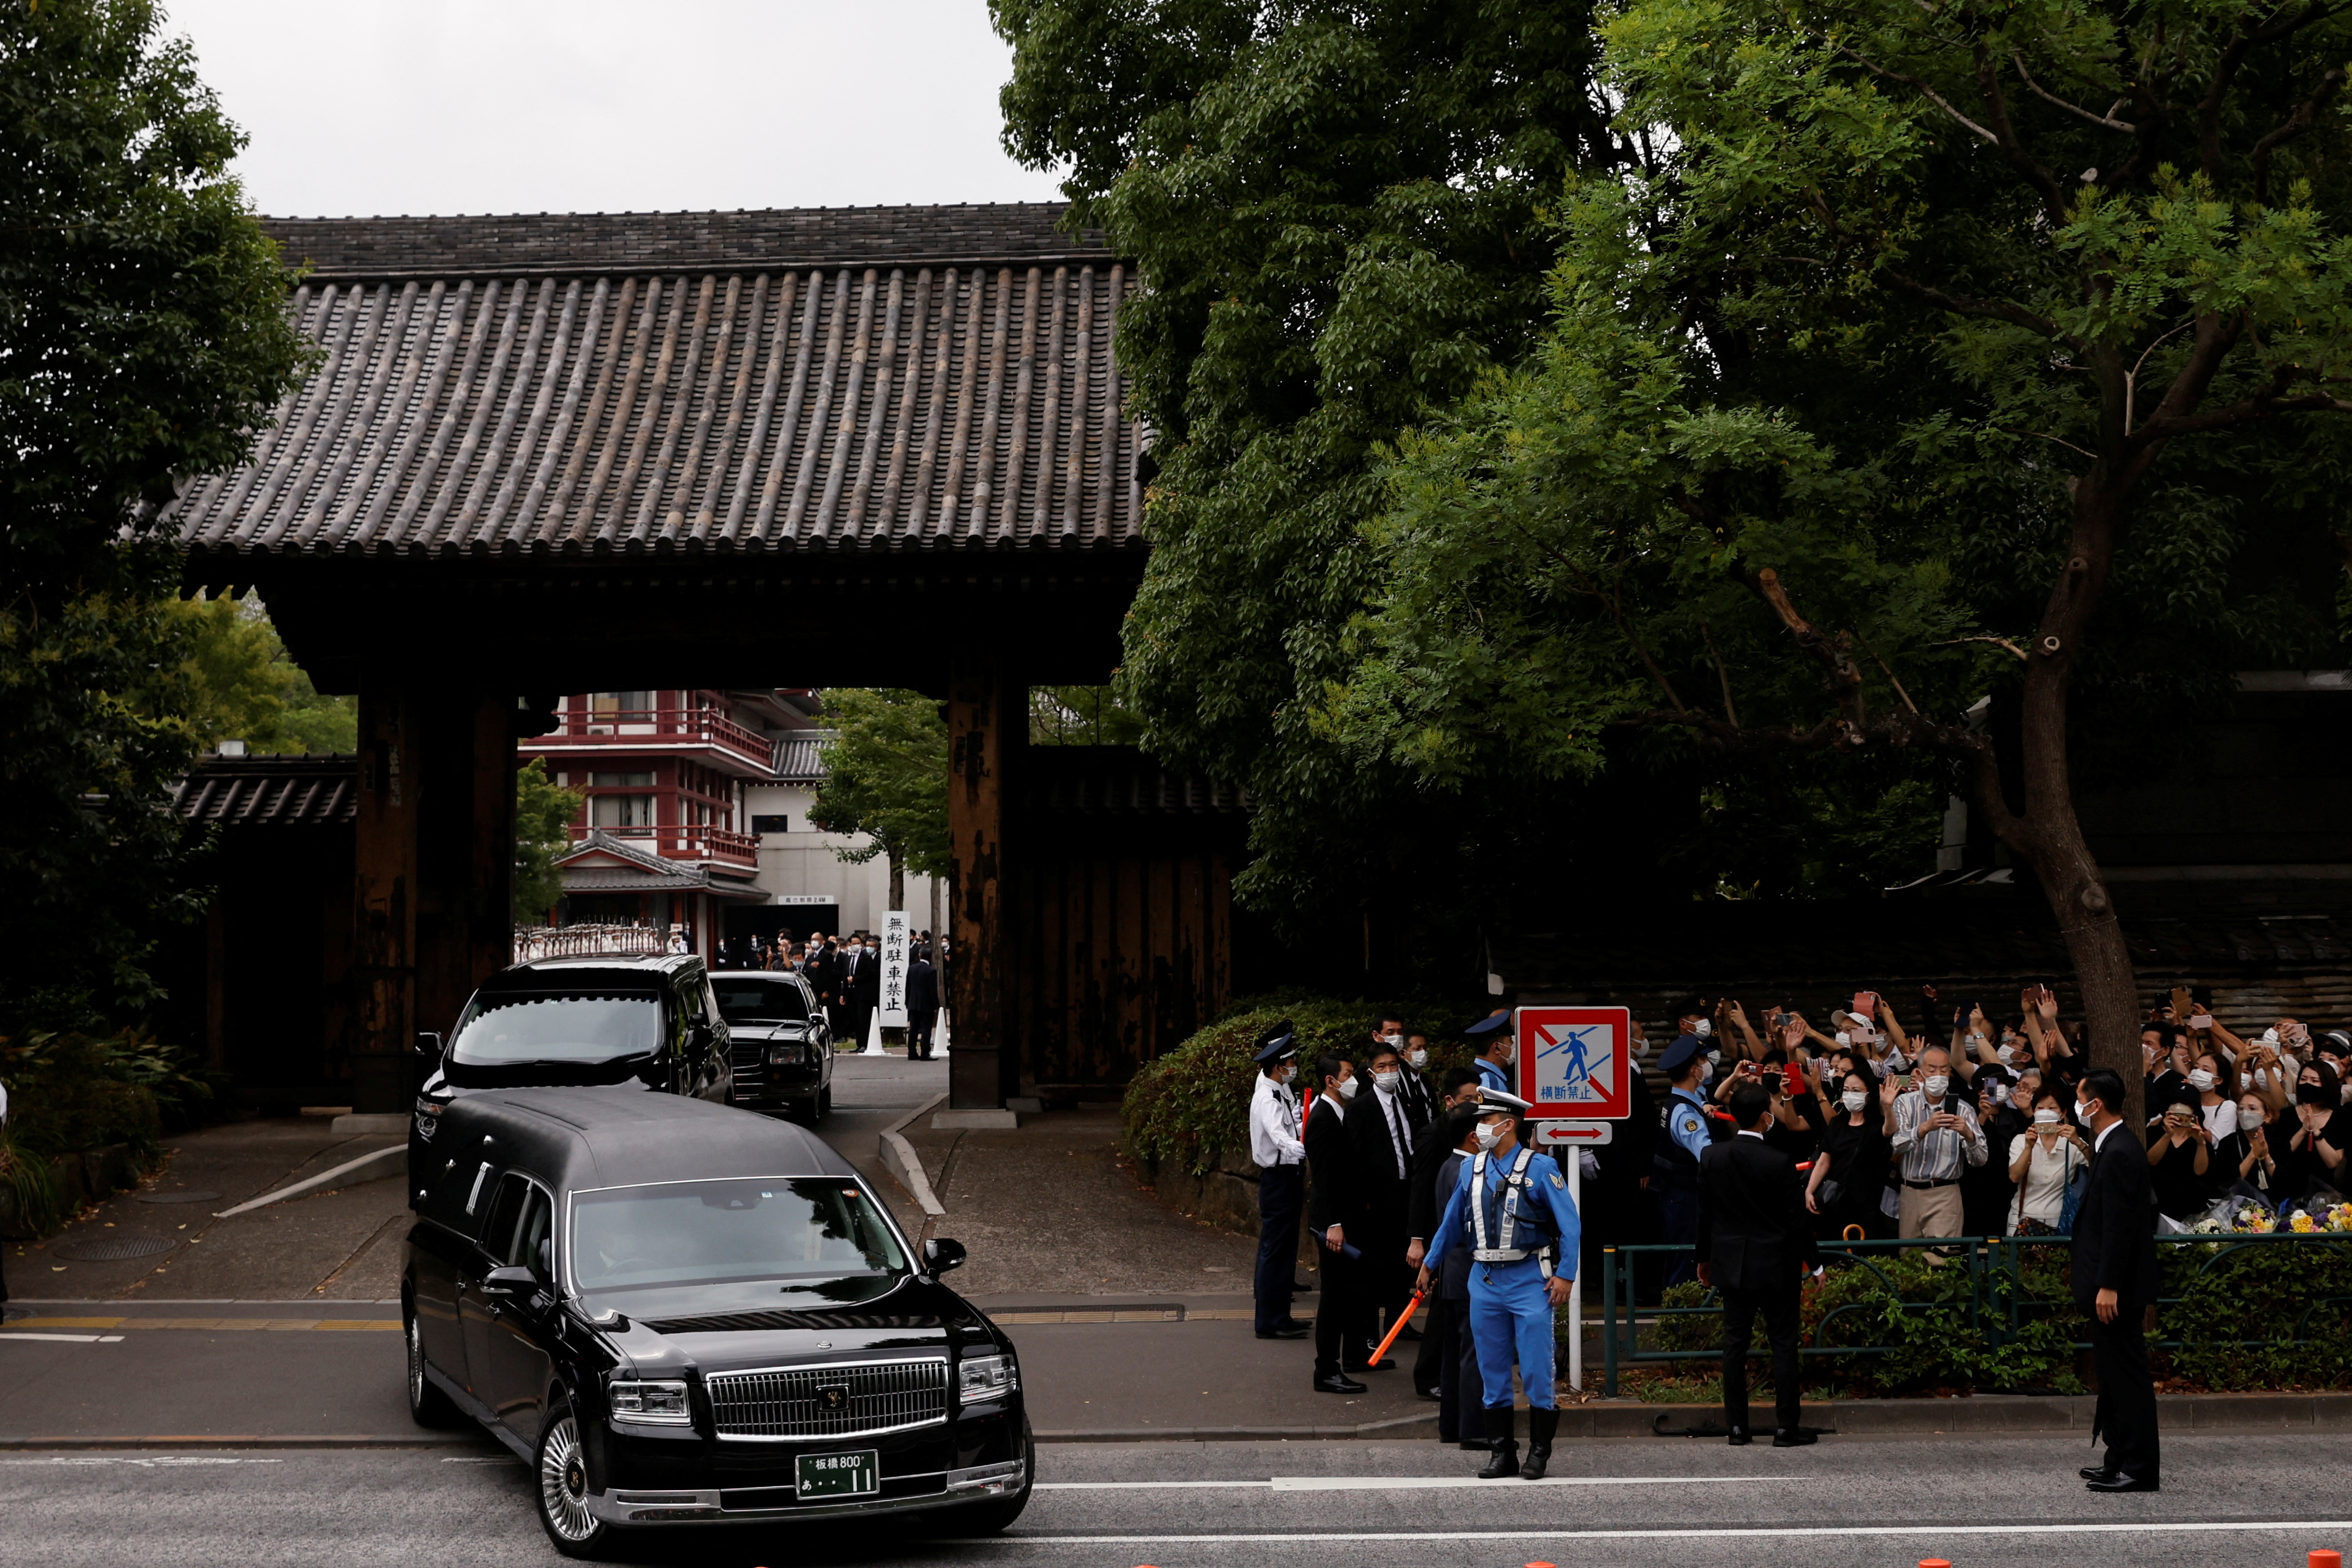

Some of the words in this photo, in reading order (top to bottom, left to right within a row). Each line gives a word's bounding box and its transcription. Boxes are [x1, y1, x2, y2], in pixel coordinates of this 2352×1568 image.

[885, 917, 904, 1011] 無断駐車禁止
[1541, 1086, 1592, 1099] 横断禁止
